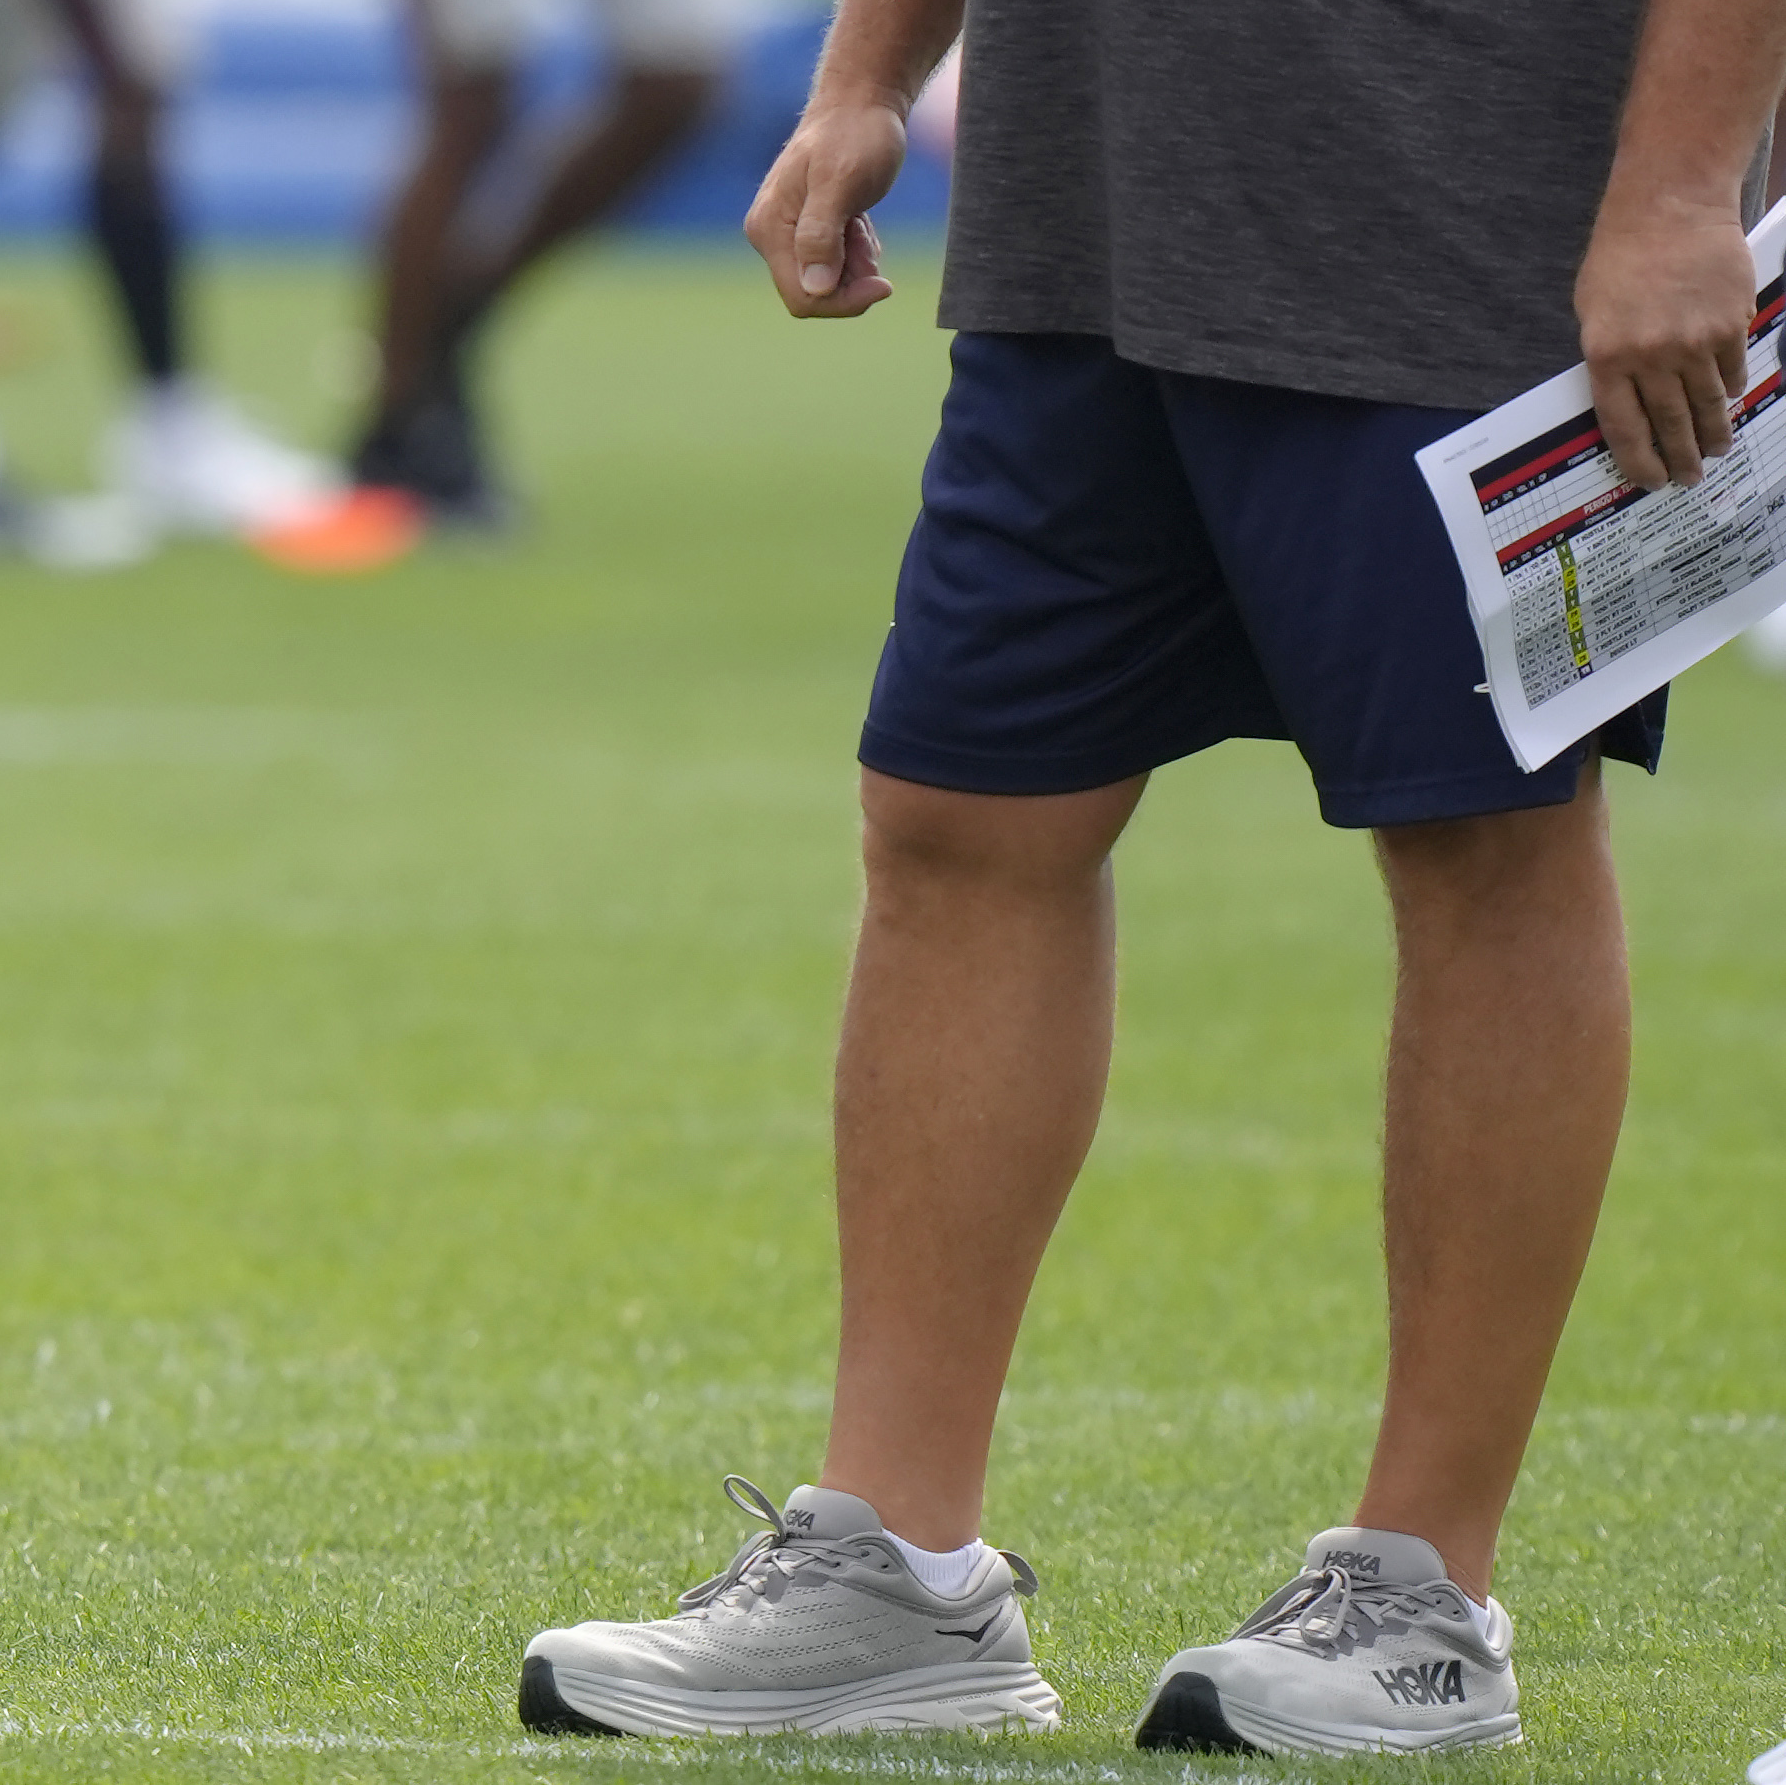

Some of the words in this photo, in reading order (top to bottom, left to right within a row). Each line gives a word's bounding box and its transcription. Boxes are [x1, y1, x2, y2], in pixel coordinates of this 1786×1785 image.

[784, 1508, 816, 1531] OKA
[1321, 1550, 1381, 1575] HOKA
[1371, 1659, 1467, 1705] HOKA
